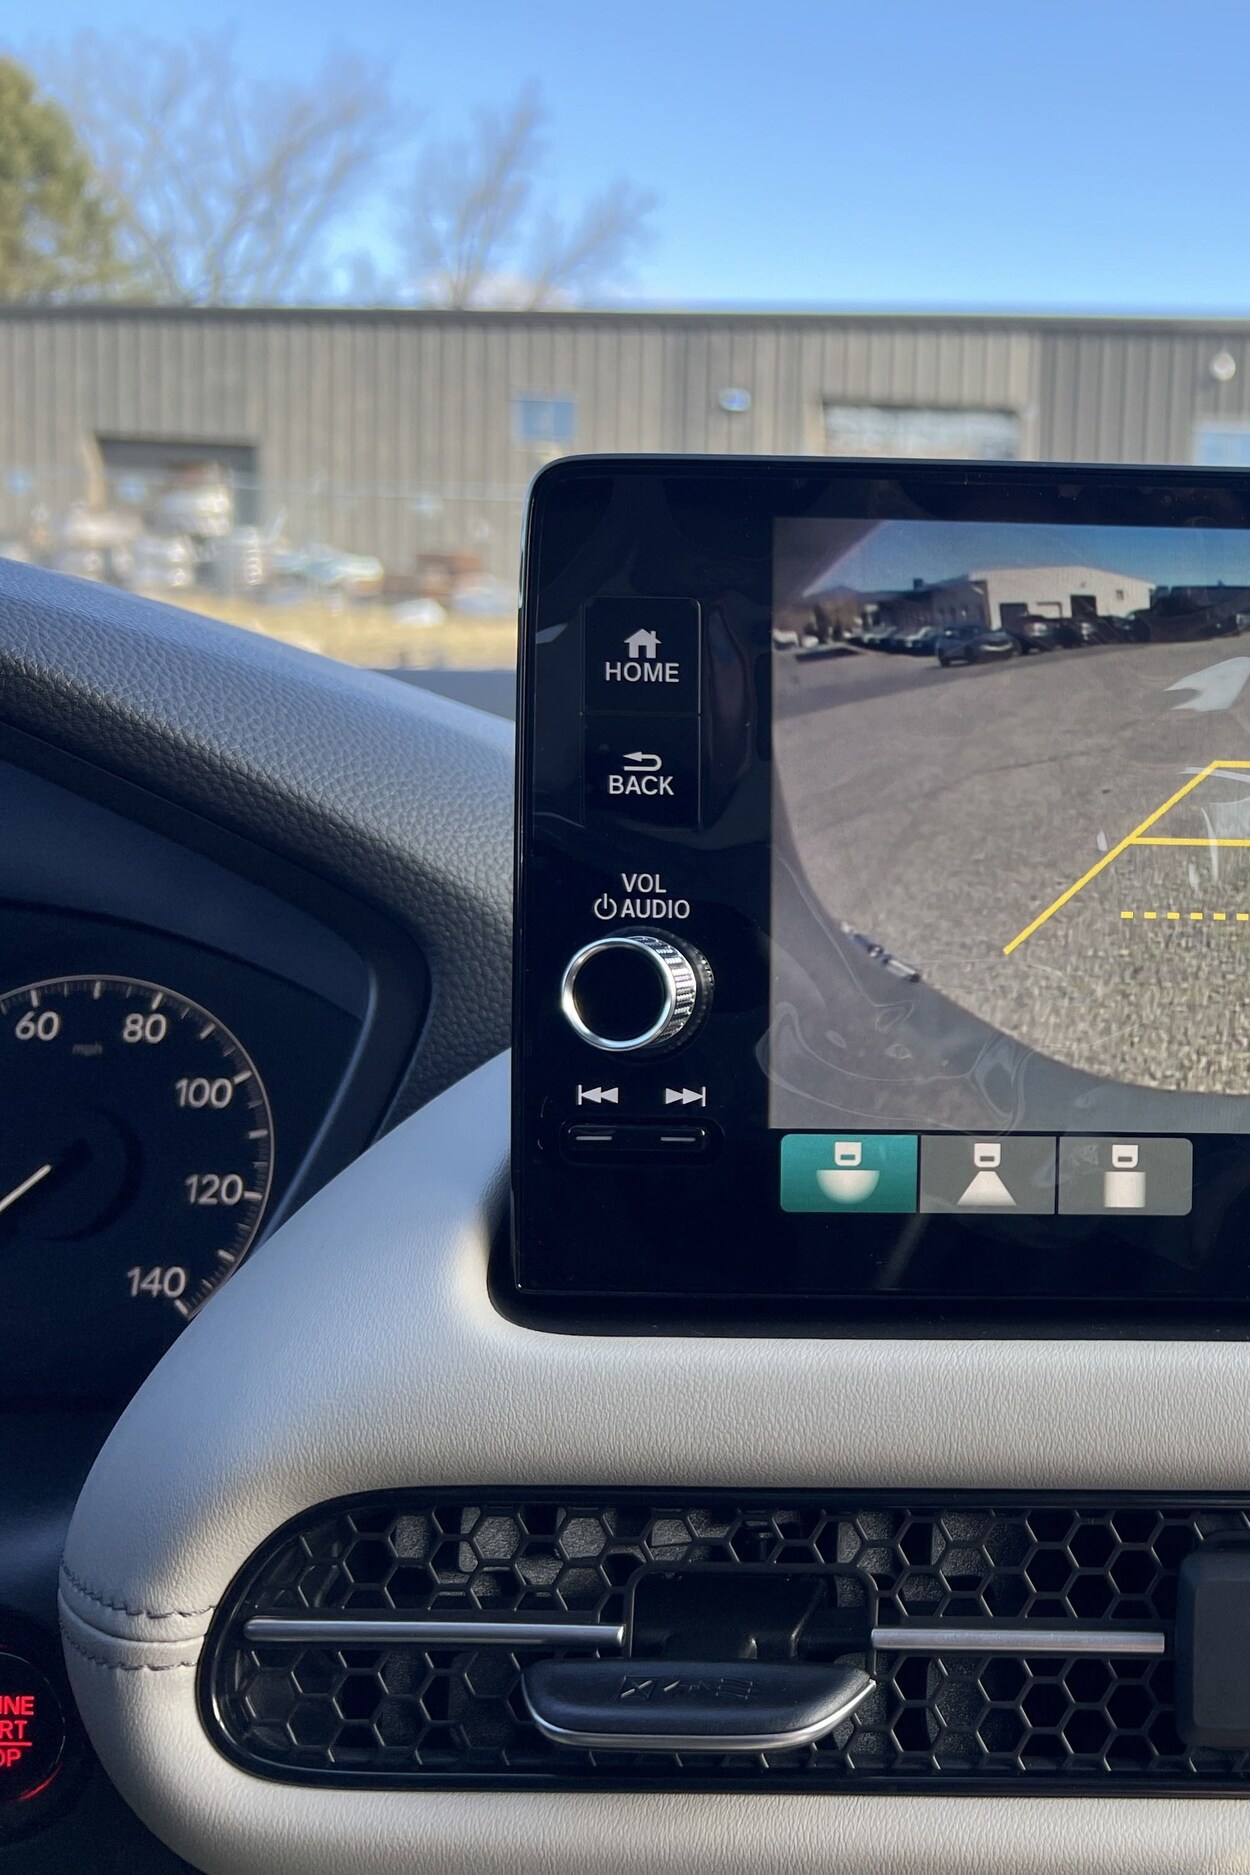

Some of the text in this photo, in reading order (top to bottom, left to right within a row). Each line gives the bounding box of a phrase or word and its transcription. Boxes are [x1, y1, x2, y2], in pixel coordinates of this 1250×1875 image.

[605, 662, 680, 683] HOME
[608, 775, 674, 795] BACK
[622, 873, 667, 893] VOL
[621, 899, 690, 919] AUDIO
[15, 1011, 59, 1041] 60
[122, 1013, 167, 1043] 80
[175, 1078, 233, 1109] 100
[185, 1174, 243, 1205] 120
[127, 1266, 186, 1298] 140
